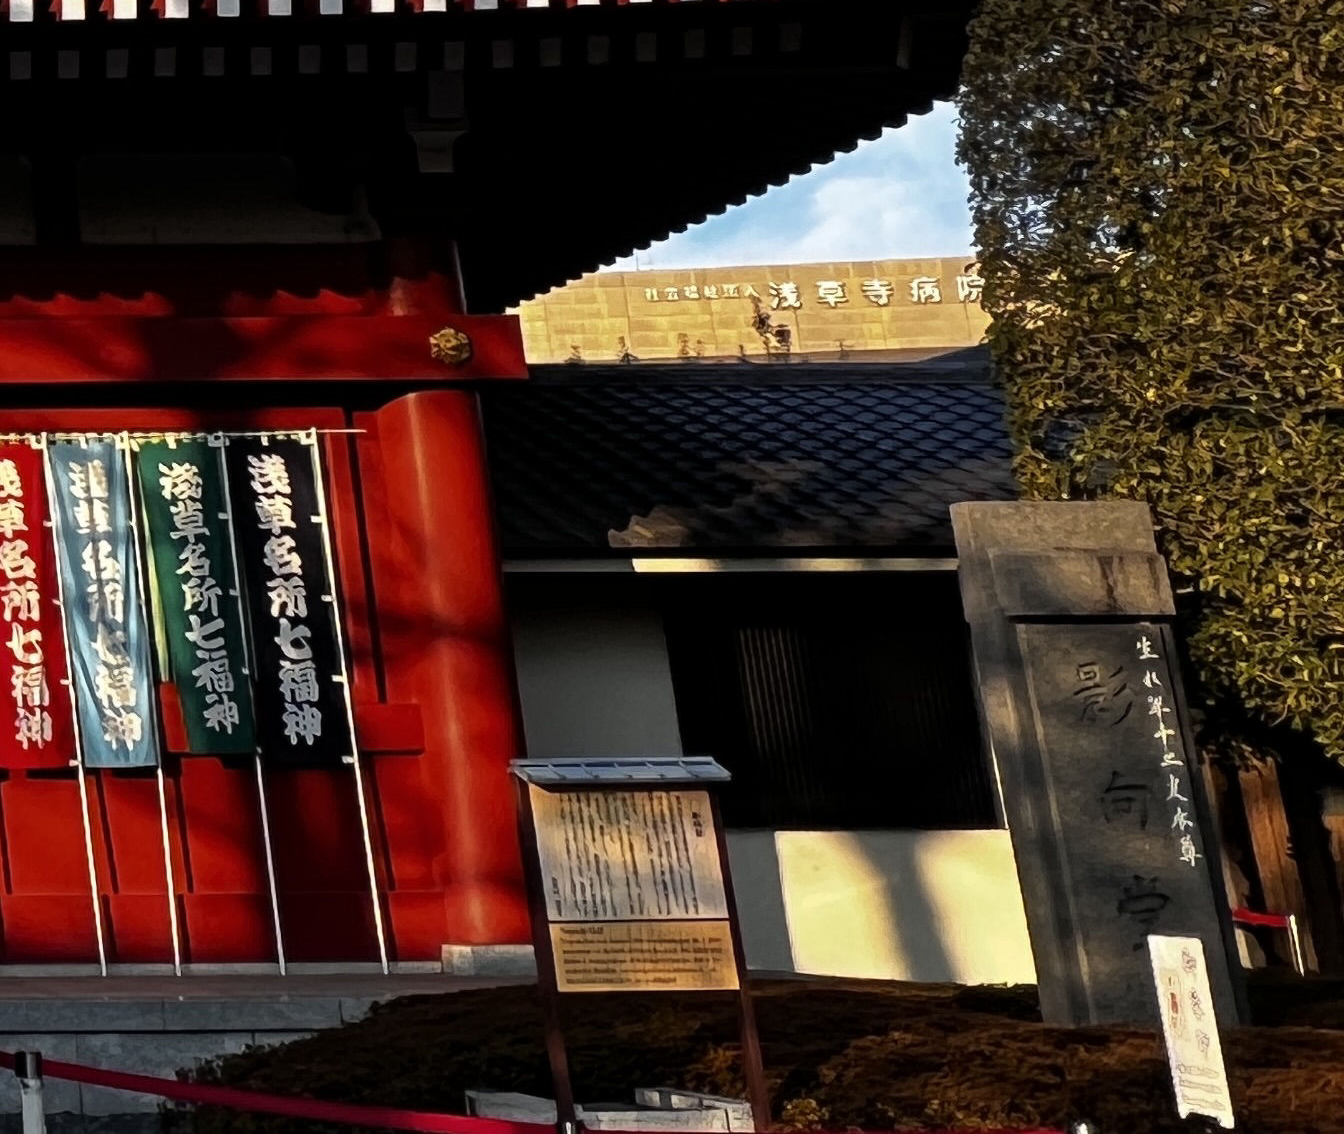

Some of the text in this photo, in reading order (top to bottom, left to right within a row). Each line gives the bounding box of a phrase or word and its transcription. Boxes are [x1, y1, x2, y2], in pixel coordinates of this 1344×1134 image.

[768, 274, 986, 310] 浅草寺病院
[246, 453, 323, 746] 浅草名所七福神
